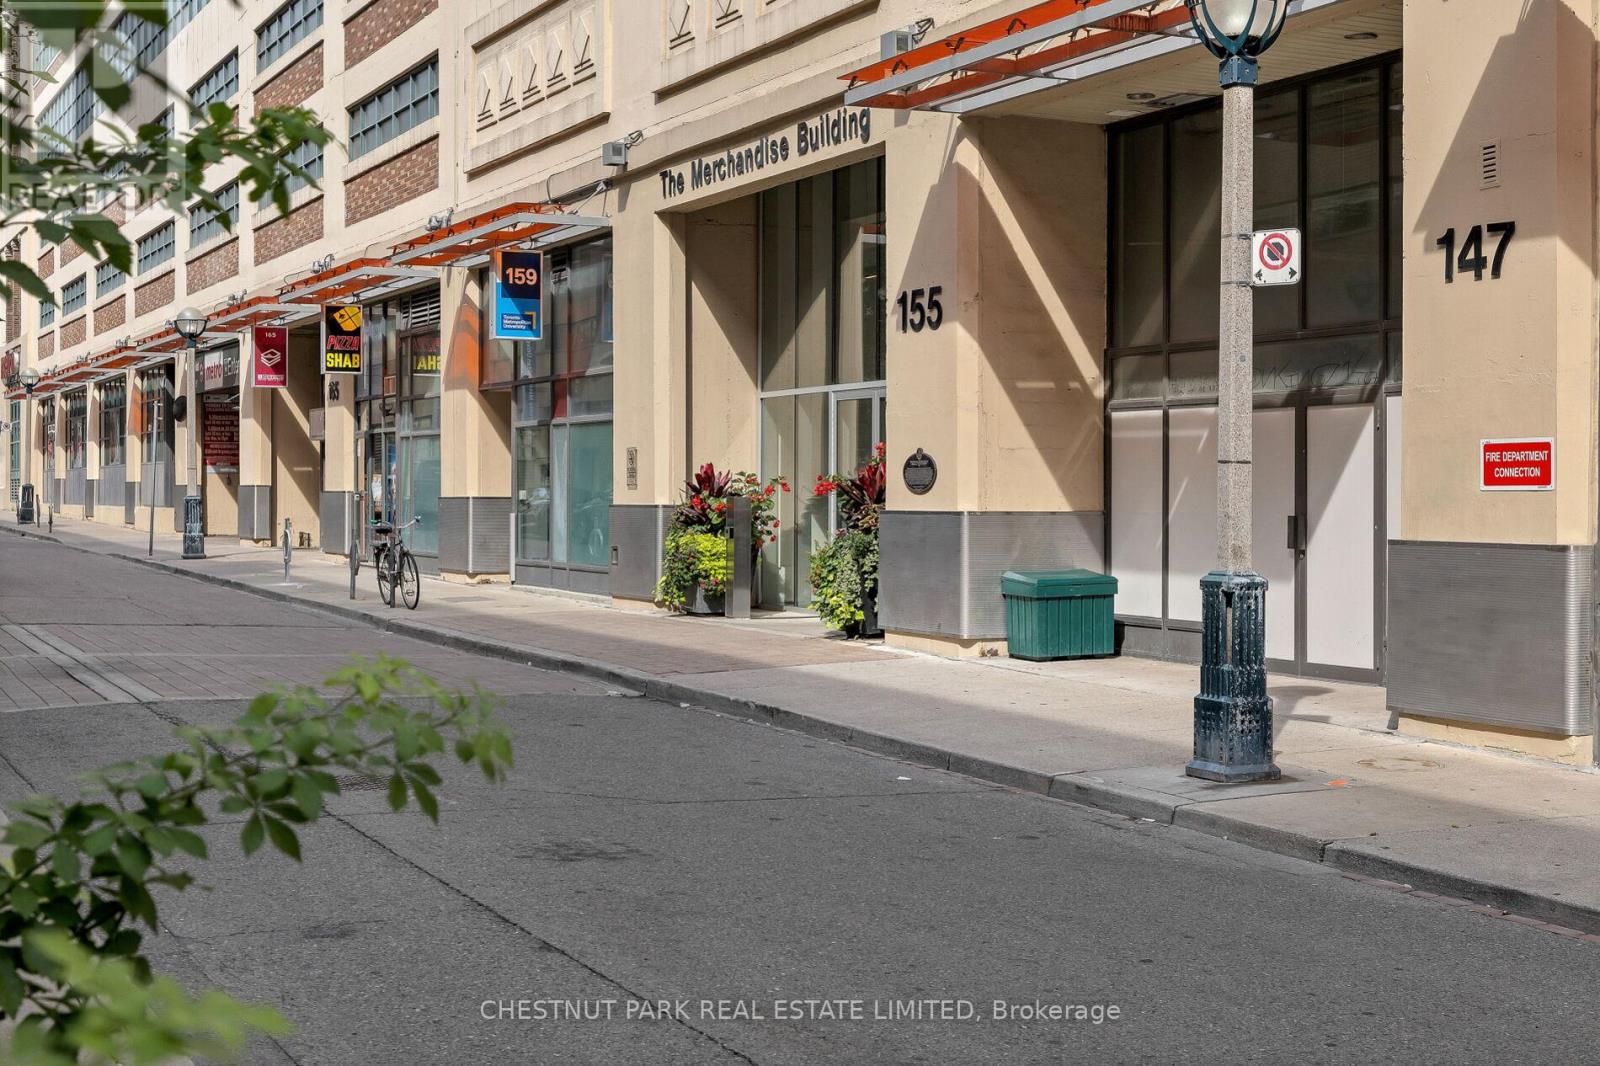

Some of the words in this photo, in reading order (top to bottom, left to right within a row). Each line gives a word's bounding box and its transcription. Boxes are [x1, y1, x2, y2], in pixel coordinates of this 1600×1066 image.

[659, 169, 685, 199] The
[690, 136, 790, 190] Merchandise
[796, 106, 871, 157] Building
[1436, 220, 1516, 284] 147
[505, 267, 538, 286] 159
[896, 285, 943, 334] 155
[326, 334, 360, 351] PIZZA
[326, 352, 361, 368] SHAB
[205, 361, 223, 380] metro
[1485, 451, 1501, 462] FIRE
[1502, 450, 1549, 462] DEPARTMENT
[1494, 466, 1541, 478] CONNECTION
